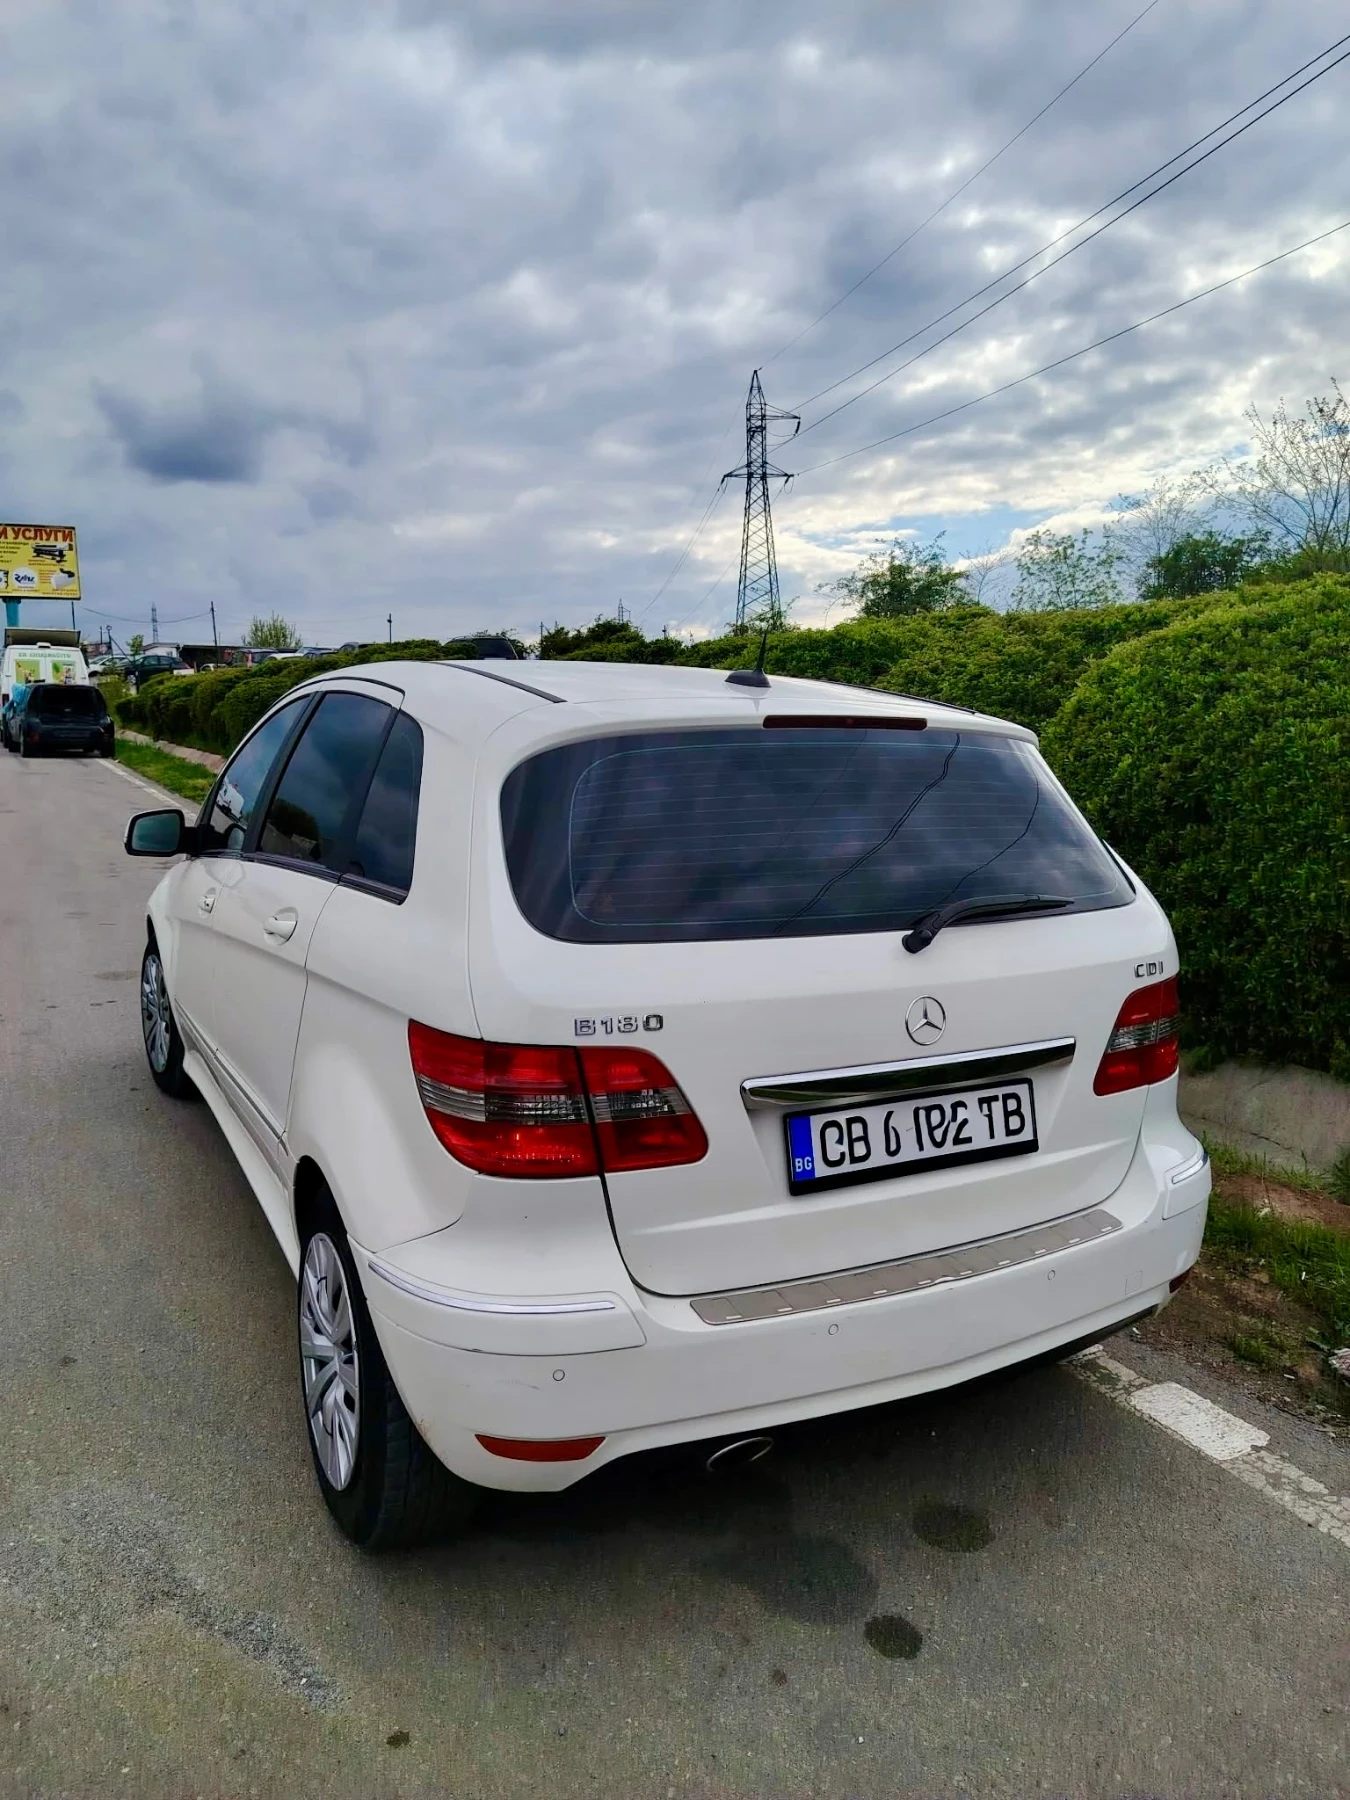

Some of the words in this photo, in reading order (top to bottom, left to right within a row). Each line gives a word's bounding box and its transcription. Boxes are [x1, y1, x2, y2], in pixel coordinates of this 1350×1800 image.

[11, 527, 74, 542] УСЛУГИ
[1133, 960, 1164, 978] CDI
[574, 1014, 664, 1036] B180
[795, 1157, 813, 1173] BG
